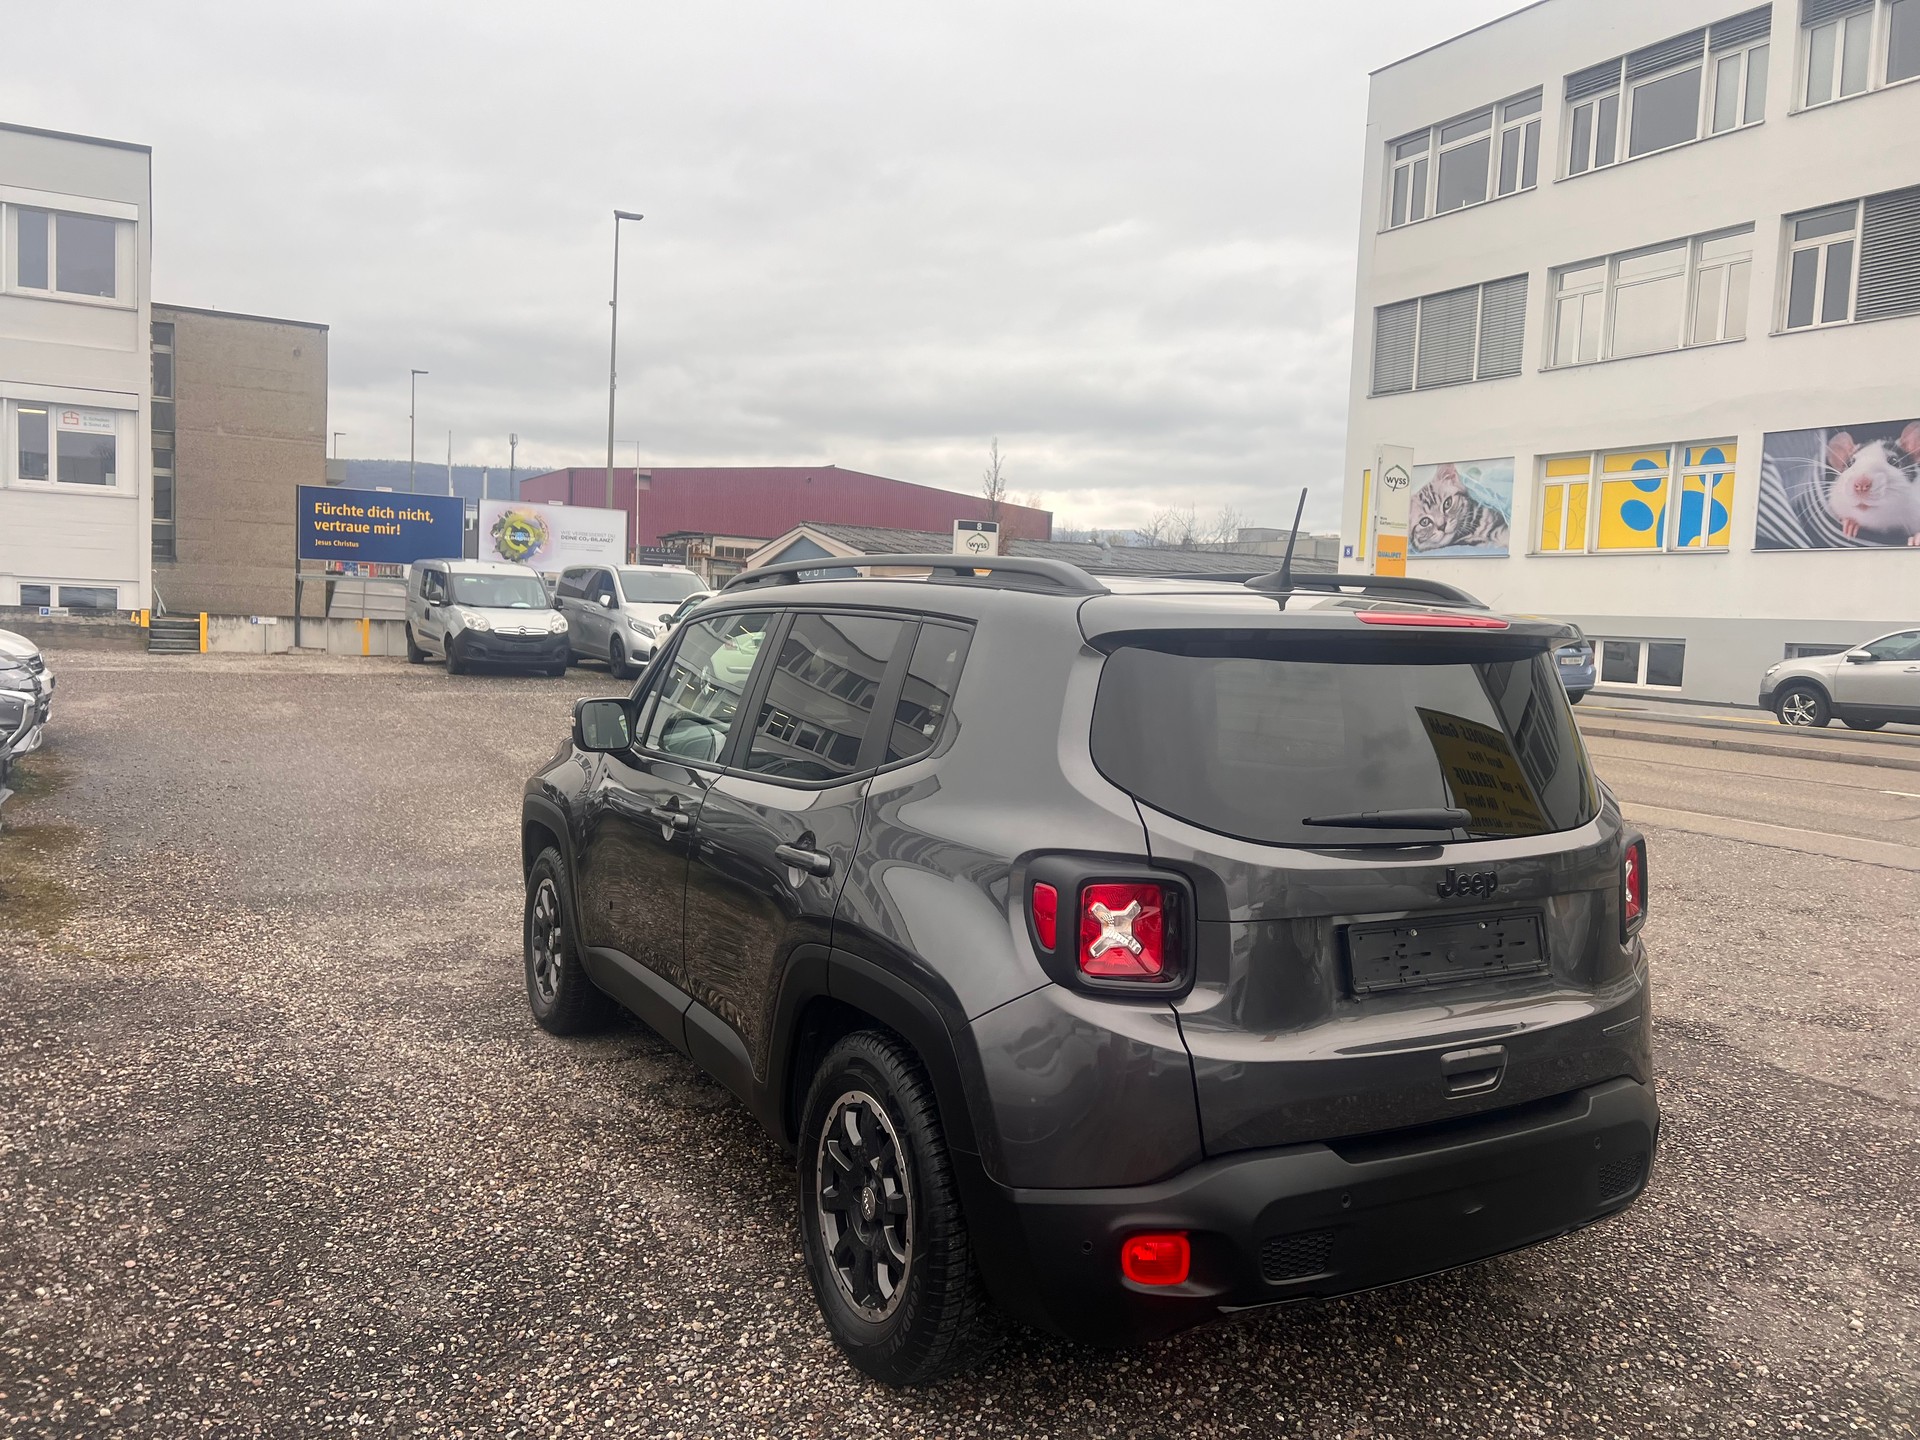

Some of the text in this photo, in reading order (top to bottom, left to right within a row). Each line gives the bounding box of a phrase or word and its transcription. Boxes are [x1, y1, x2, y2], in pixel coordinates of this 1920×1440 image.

[1386, 476, 1407, 492] wyss
[315, 502, 434, 524] Fürchte dich nicht,
[314, 520, 401, 536] vertraue mir!
[976, 522, 983, 531] 8
[315, 538, 360, 548] Jesus Christus
[968, 542, 987, 554] wyss
[1437, 867, 1498, 899] Jeep
